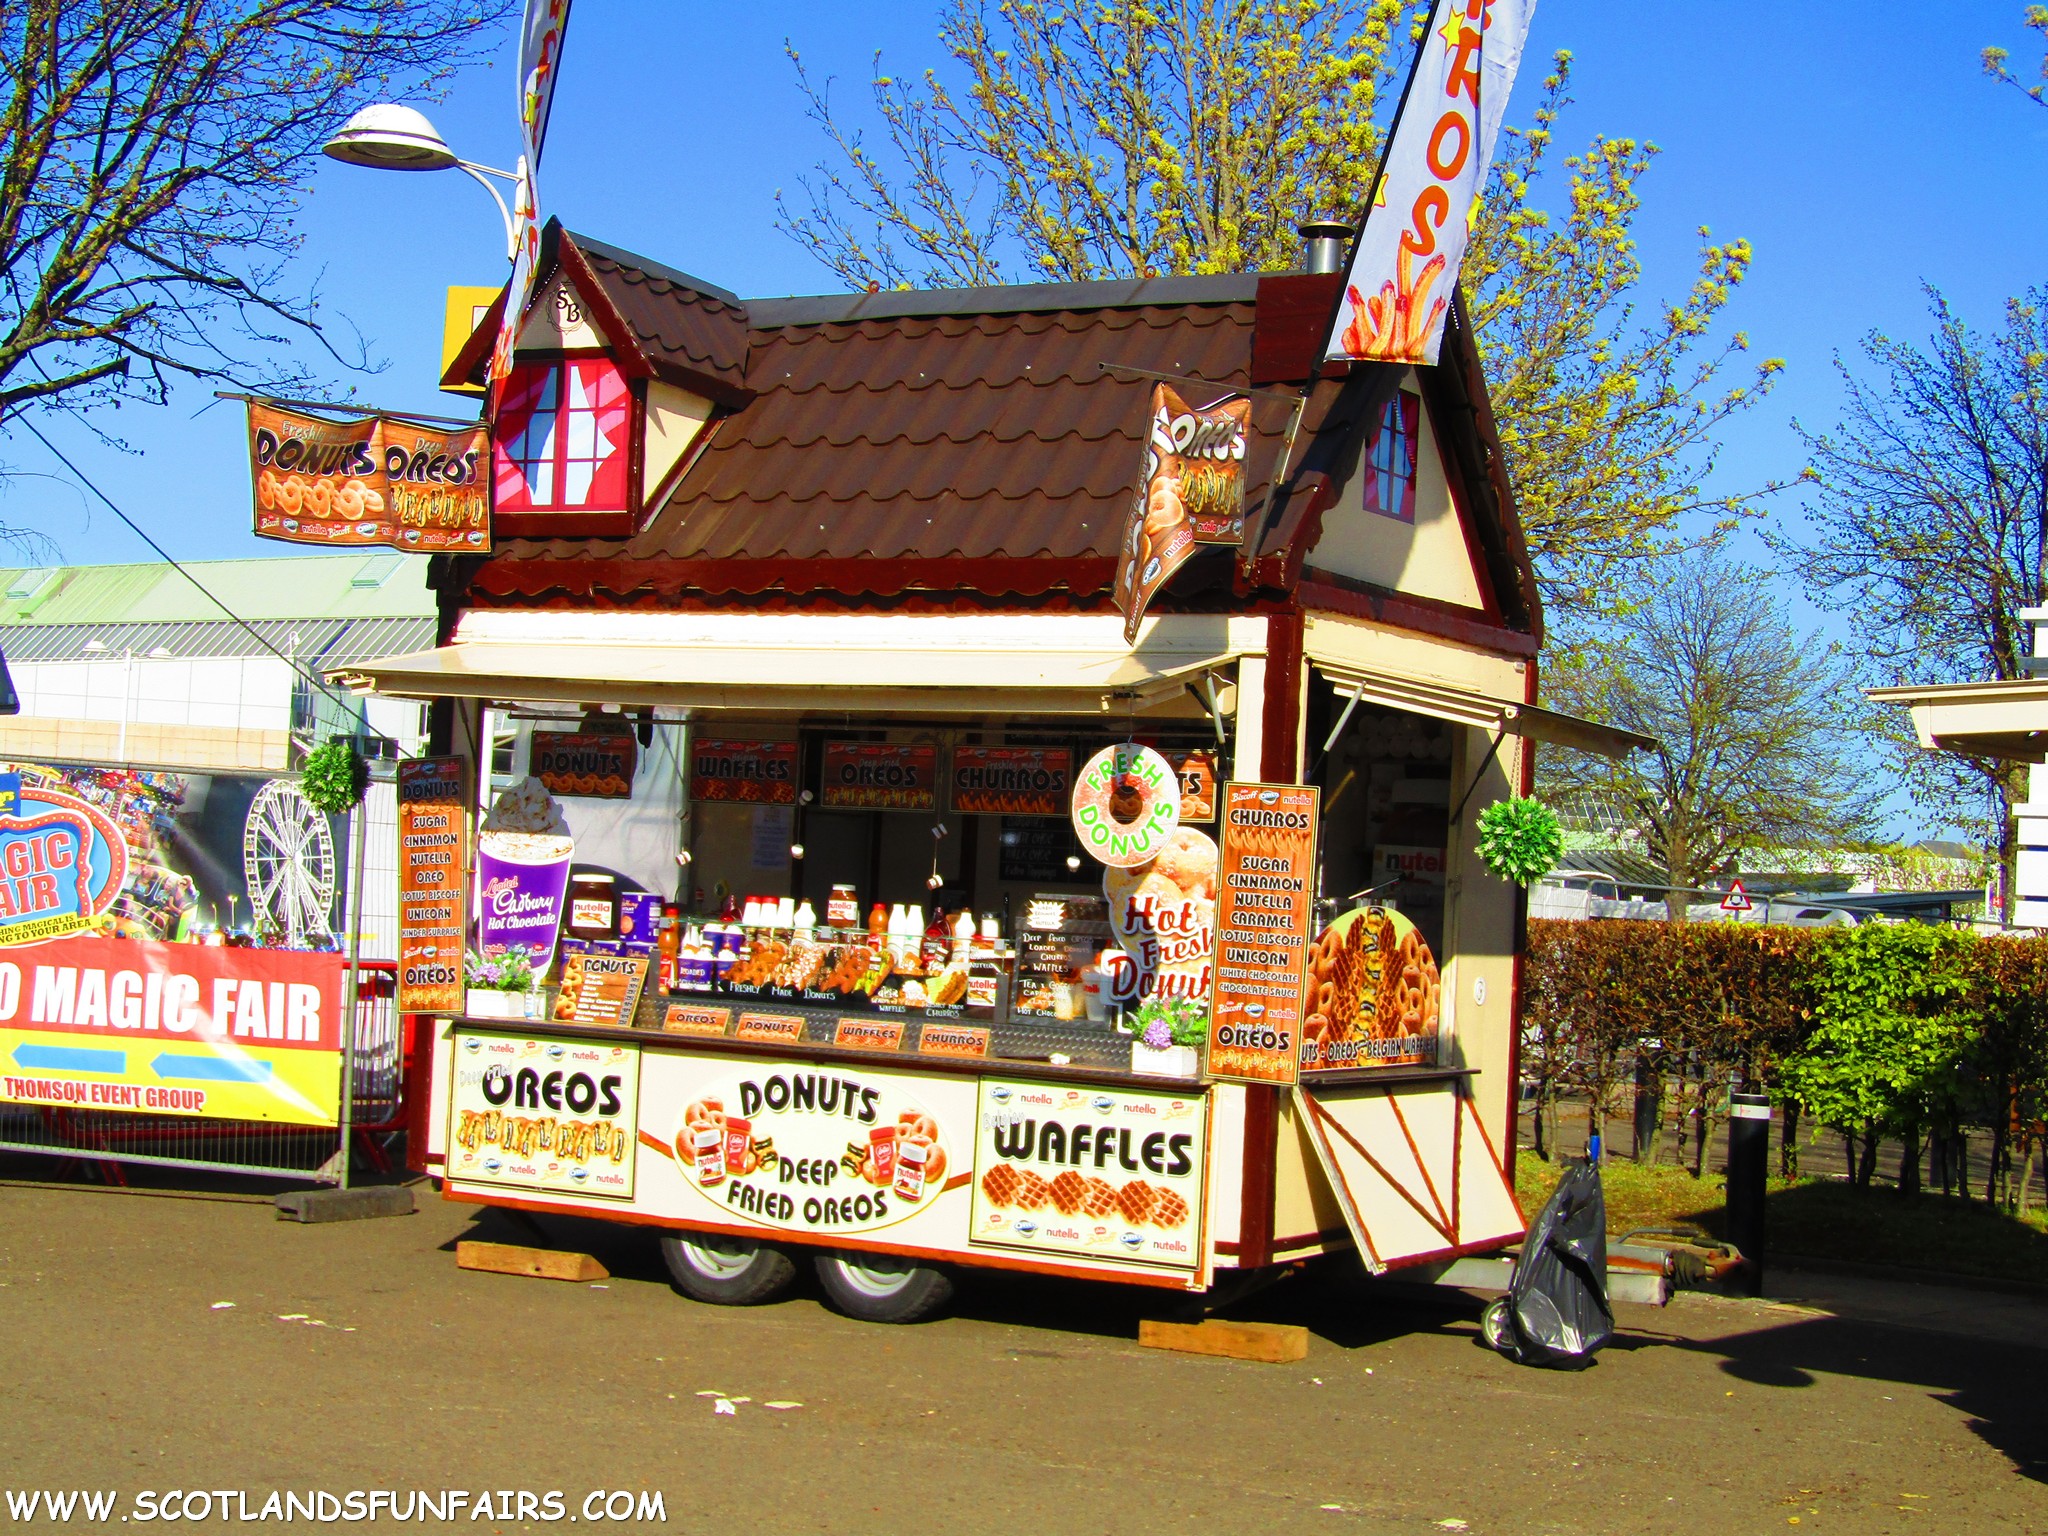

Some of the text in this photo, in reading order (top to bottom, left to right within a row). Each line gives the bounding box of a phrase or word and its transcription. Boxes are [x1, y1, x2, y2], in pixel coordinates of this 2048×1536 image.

[256, 426, 377, 477] DONUTS
[385, 444, 479, 485] OREOS
[302, 525, 326, 536] nutella
[1164, 526, 1193, 558] nutella
[540, 752, 622, 774] DONUTS
[698, 755, 790, 781] WAFFLES
[840, 763, 918, 787] OREOS
[956, 766, 1065, 792] CHURROS
[1086, 753, 1164, 792] FRESH
[403, 781, 459, 799] DONUTS
[1231, 790, 1258, 802] Biscoff
[1283, 795, 1311, 805] nutella
[413, 816, 447, 828] SUGAR
[1230, 809, 1309, 828] CHURROS
[1079, 802, 1174, 857] DONUTS
[404, 834, 458, 847] CINNAMON
[410, 852, 451, 865] NUTELLA
[1242, 856, 1291, 872] SUGAR
[417, 871, 445, 883] OREO
[1227, 874, 1303, 892] CINNAMON
[402, 890, 461, 901] LOTUS BISCOFF
[493, 889, 555, 915] Cadbury
[1235, 892, 1293, 910] NUTELLA
[408, 908, 451, 920] UNICORN
[574, 903, 611, 912] nutella
[1125, 896, 1194, 932] Hot
[22, 917, 64, 932] MAGICAL
[65, 914, 74, 923] IS
[488, 914, 556, 930] Hot Chocolate
[1231, 911, 1294, 929] CARAMEL
[16, 932, 29, 942] TO
[30, 925, 60, 939] YOUR
[62, 918, 91, 933] AREA
[402, 927, 461, 938] KINDER SURPRISE
[1220, 930, 1303, 947] LOTUS BISCOFF
[1029, 944, 1056, 952] LOADED
[1226, 948, 1289, 966] UNICORN
[583, 959, 637, 975] DONUTS
[1219, 967, 1299, 983] WHITE CHOCOLATE
[405, 967, 456, 986] OREOS
[1019, 979, 1038, 989] TEA
[1218, 982, 1298, 998] CHOCOLATE SAUCE
[31, 965, 200, 1033] MAGIC
[211, 977, 321, 1042] FAIR
[676, 1014, 716, 1024] OREOS
[1268, 1009, 1297, 1019] nutella
[745, 1022, 794, 1033] DONUTS
[843, 1026, 896, 1038] WAFFLES
[925, 1033, 983, 1046] CHURROS
[1218, 1025, 1290, 1051] OREOS
[489, 1044, 515, 1053] nutella
[572, 1051, 599, 1061] nutella
[1327, 1040, 1358, 1061] OREOS
[1366, 1037, 1402, 1058] BELGIAN
[4, 1077, 205, 1109] THOMSON EVENT GROUP
[482, 1066, 622, 1117] OREOS
[739, 1073, 881, 1125] DONUTS
[1021, 1094, 1053, 1104] nutella
[1124, 1103, 1156, 1114] nutella
[994, 1119, 1193, 1177] WAFFLES
[698, 1154, 723, 1168] nutella
[509, 1165, 536, 1175] nutella
[596, 1174, 624, 1185] nutella
[779, 1156, 838, 1187] DEEP
[897, 1168, 922, 1182] nutella
[727, 1179, 888, 1224] FRIED OREOS
[1046, 1228, 1079, 1239] nutella
[1153, 1241, 1187, 1252] nutella
